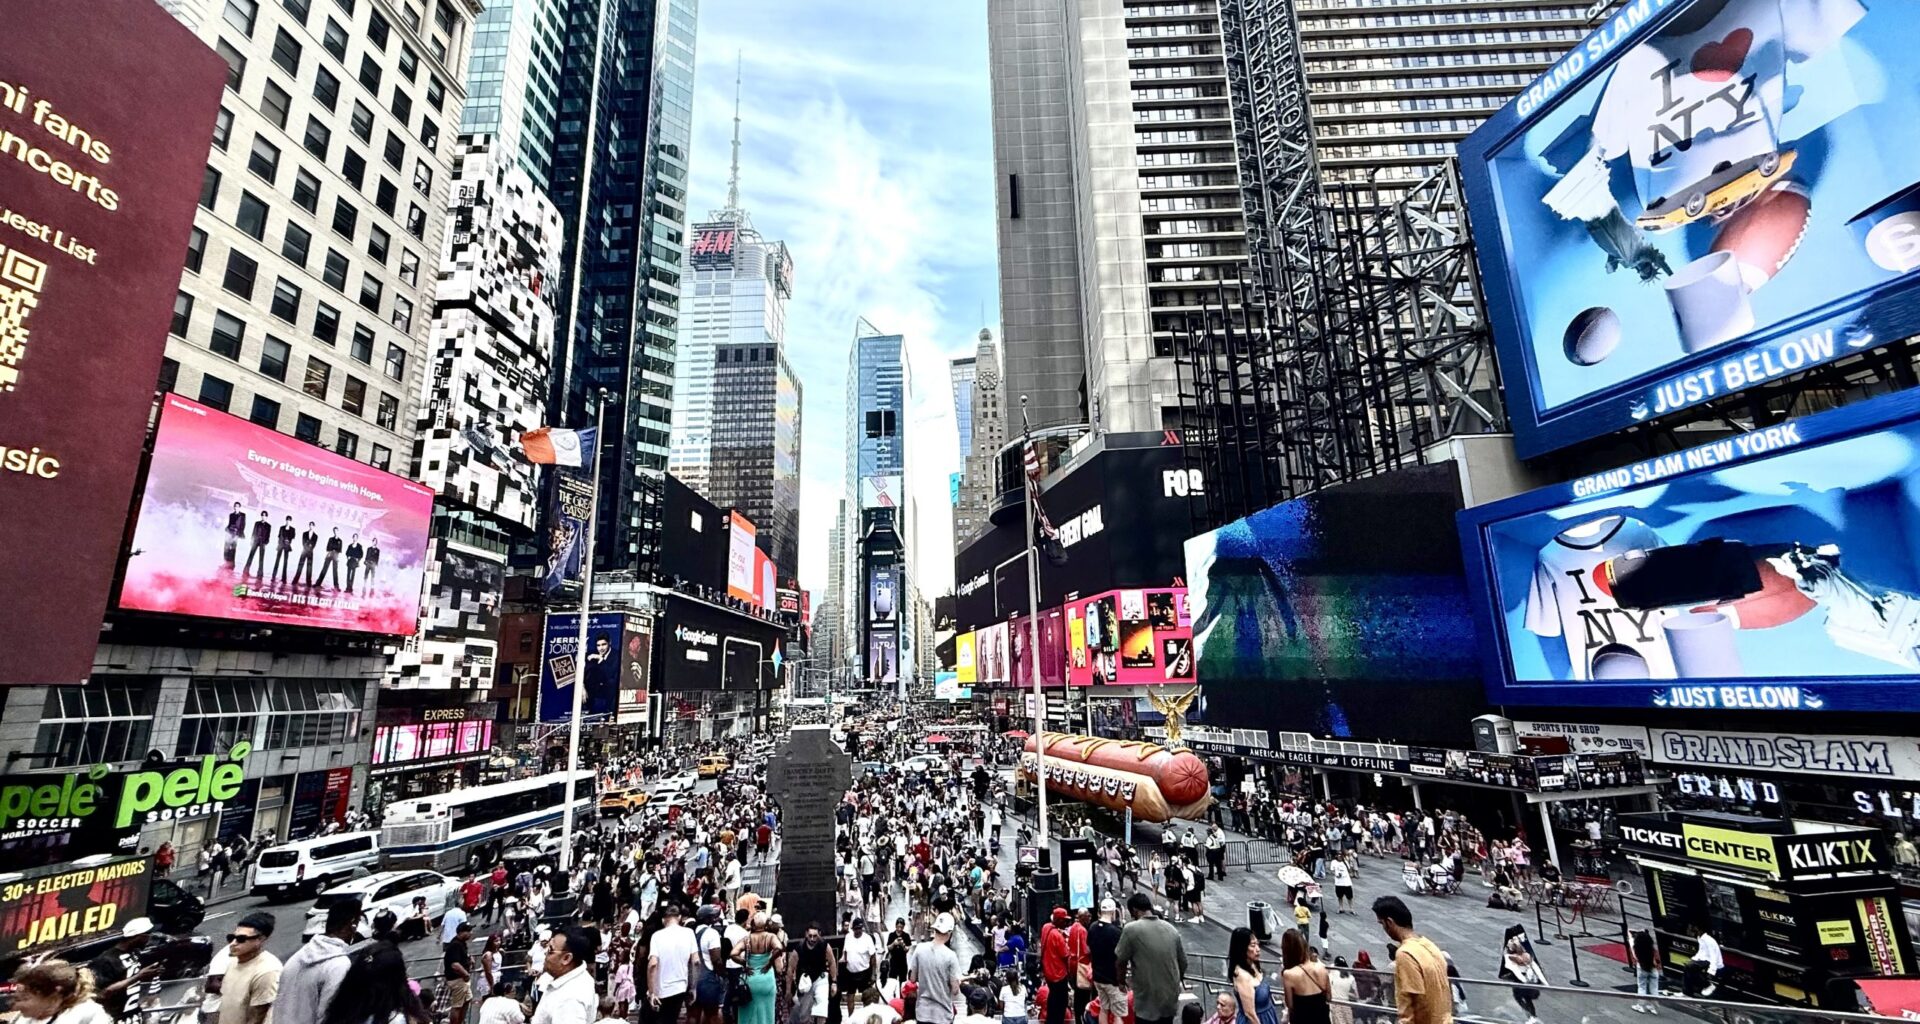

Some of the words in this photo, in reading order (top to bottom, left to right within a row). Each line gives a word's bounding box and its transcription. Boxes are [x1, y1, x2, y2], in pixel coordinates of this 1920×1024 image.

[1517, 52, 1584, 117] GRAND
[1586, 1, 1650, 60] SLAM
[1651, 59, 1683, 117] I
[33, 100, 112, 164] fans
[1648, 73, 1757, 166] NY
[0, 130, 119, 211] ncerts
[53, 230, 97, 266] List
[1654, 369, 1715, 413] JUST
[1722, 329, 1834, 390] BELOW
[248, 449, 279, 469] Every
[279, 461, 307, 478] stage
[308, 469, 339, 487] begins
[340, 481, 359, 495] with
[359, 486, 384, 502] Hope.
[1573, 469, 1631, 498] GRAND
[1633, 455, 1685, 484] SLAM
[1687, 440, 1733, 470] NEW
[1736, 422, 1801, 456] YORK
[559, 489, 572, 503] THE
[572, 496, 592, 510] GREA
[1059, 515, 1082, 548] EVERY
[960, 579, 975, 597] Google
[974, 570, 989, 590] Gemini
[1566, 568, 1597, 604] I
[682, 627, 701, 646] Google
[701, 630, 718, 646] Gemini
[1577, 607, 1655, 649] NY
[549, 643, 588, 655] JORDA
[871, 641, 896, 650] ULTRA
[1670, 688, 1715, 707] JUST
[1721, 687, 1799, 707] BELOW
[424, 709, 465, 721] EXPRESS
[1532, 723, 1561, 733] SPORTS
[1562, 724, 1578, 734] FAN
[1579, 725, 1601, 735] SHOP
[1210, 743, 1236, 754] OFFLINE
[1249, 748, 1286, 760] AMERICAN
[1288, 753, 1313, 764] EAGLE
[1350, 758, 1395, 771] OFFLINE
[115, 741, 251, 829] pelé
[1677, 774, 1780, 803] GRAND
[17, 817, 81, 829] SOCCER
[146, 801, 225, 823] SOCCER
[1, 828, 41, 840] WORLD'S
[1620, 825, 1683, 849] TICKET
[1687, 836, 1772, 865] CENTER
[1787, 839, 1877, 869] KLIKTIX
[2, 882, 35, 902] 30+
[36, 868, 94, 896] ELECTED
[96, 859, 146, 886] MAYORS
[17, 903, 118, 950] JAILED
[1758, 909, 1796, 925] KLIKPIX
[1875, 900, 1892, 946] SQUARE
[1869, 914, 1887, 960] CENTER
